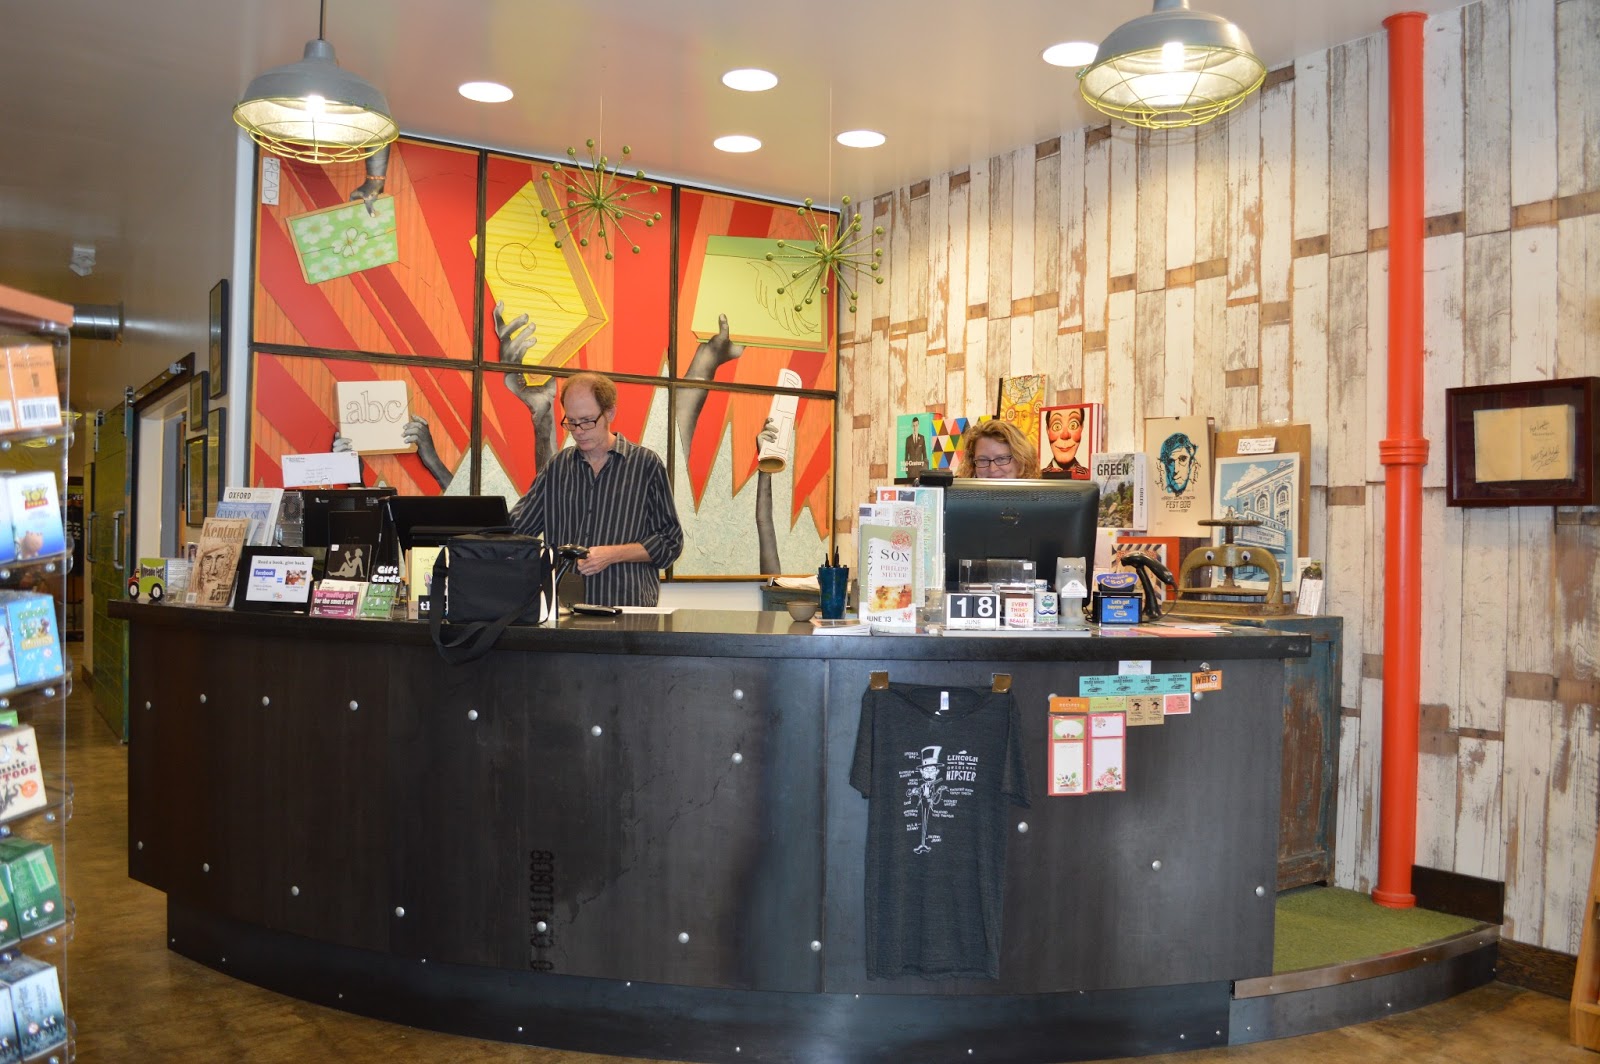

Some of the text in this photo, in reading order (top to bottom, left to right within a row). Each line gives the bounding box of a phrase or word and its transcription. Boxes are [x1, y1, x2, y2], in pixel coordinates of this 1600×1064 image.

[264, 161, 278, 201] READ
[346, 390, 402, 424] abc
[1097, 463, 1129, 476] GREEN
[21, 487, 48, 502] TOY
[228, 491, 252, 499] OXFORD
[251, 510, 268, 519] GUN
[203, 522, 247, 538] Kentuck
[881, 548, 910, 562] SON
[377, 565, 398, 574] Gift
[880, 564, 908, 572] PHILIPP
[372, 574, 401, 583] Cards
[956, 596, 993, 617] 18
[1195, 674, 1210, 684] WHY
[947, 754, 978, 762] LINCOLN
[0, 759, 26, 774] assic
[0, 763, 37, 782] TOOS
[946, 770, 977, 782] HIPSTER
